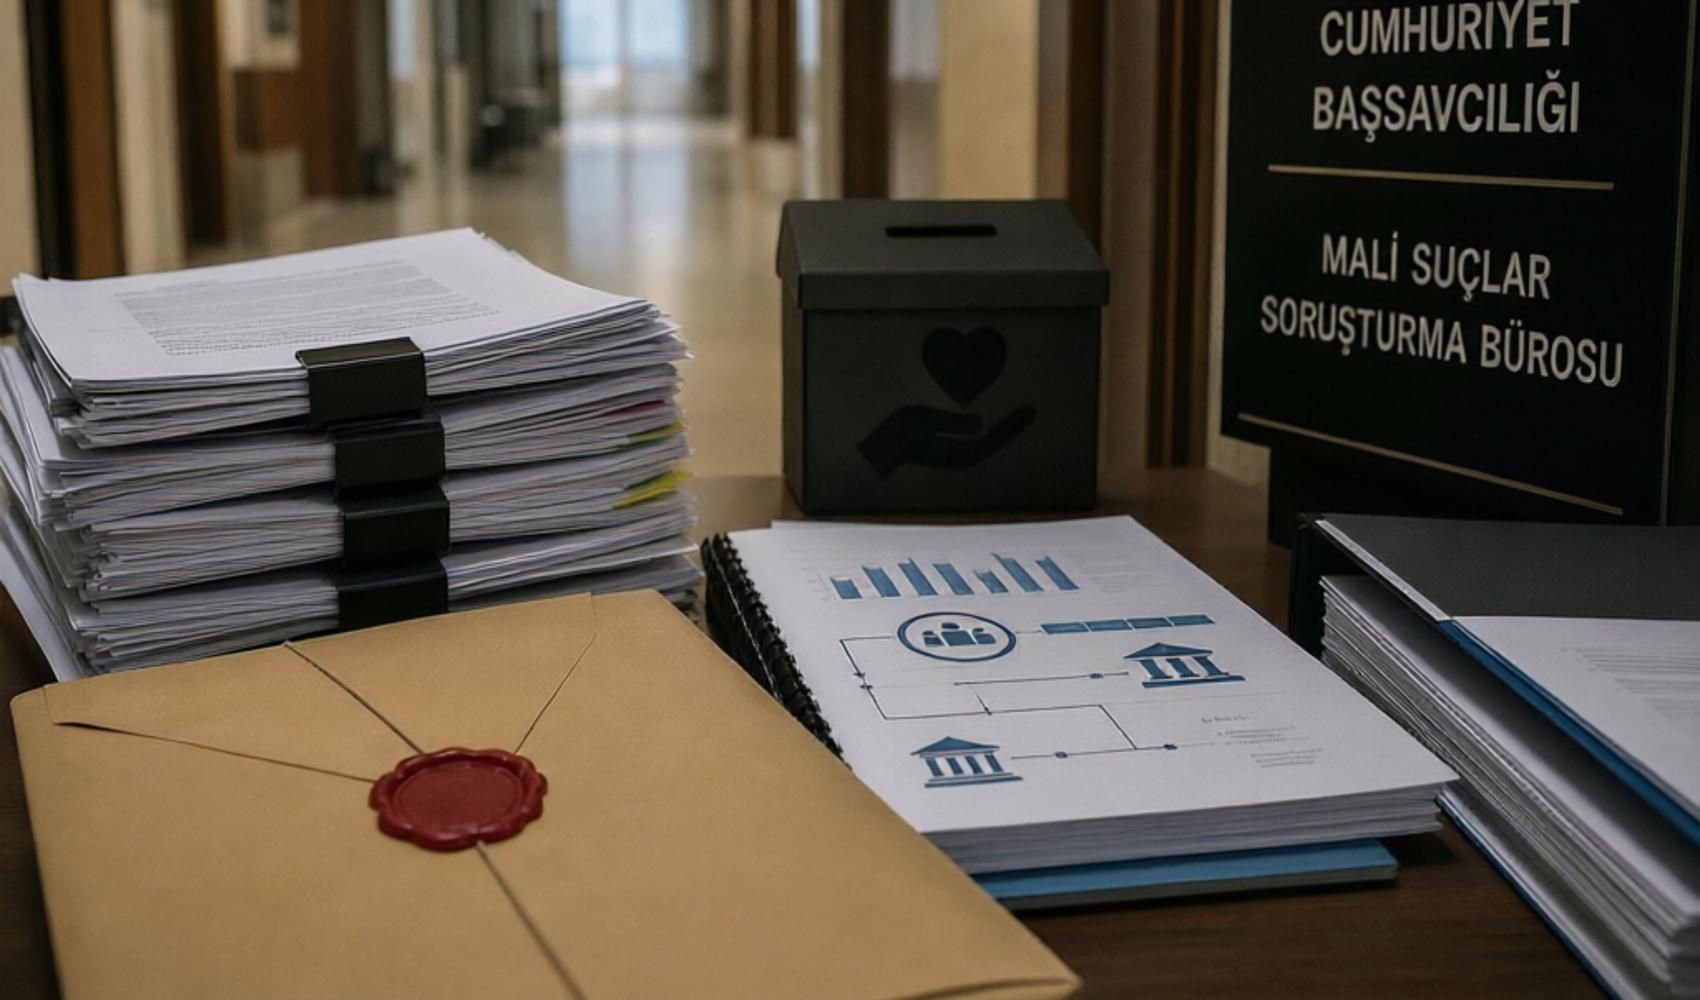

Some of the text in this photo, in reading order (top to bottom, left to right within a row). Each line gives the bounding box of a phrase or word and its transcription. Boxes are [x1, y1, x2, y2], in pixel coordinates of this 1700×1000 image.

[1312, 69, 1580, 143] BAŞSAVCILIĞI
[1322, 231, 1551, 302] MALİ SUÇLAR
[1260, 295, 1623, 388] SORUŞTURMA BÜROSU
